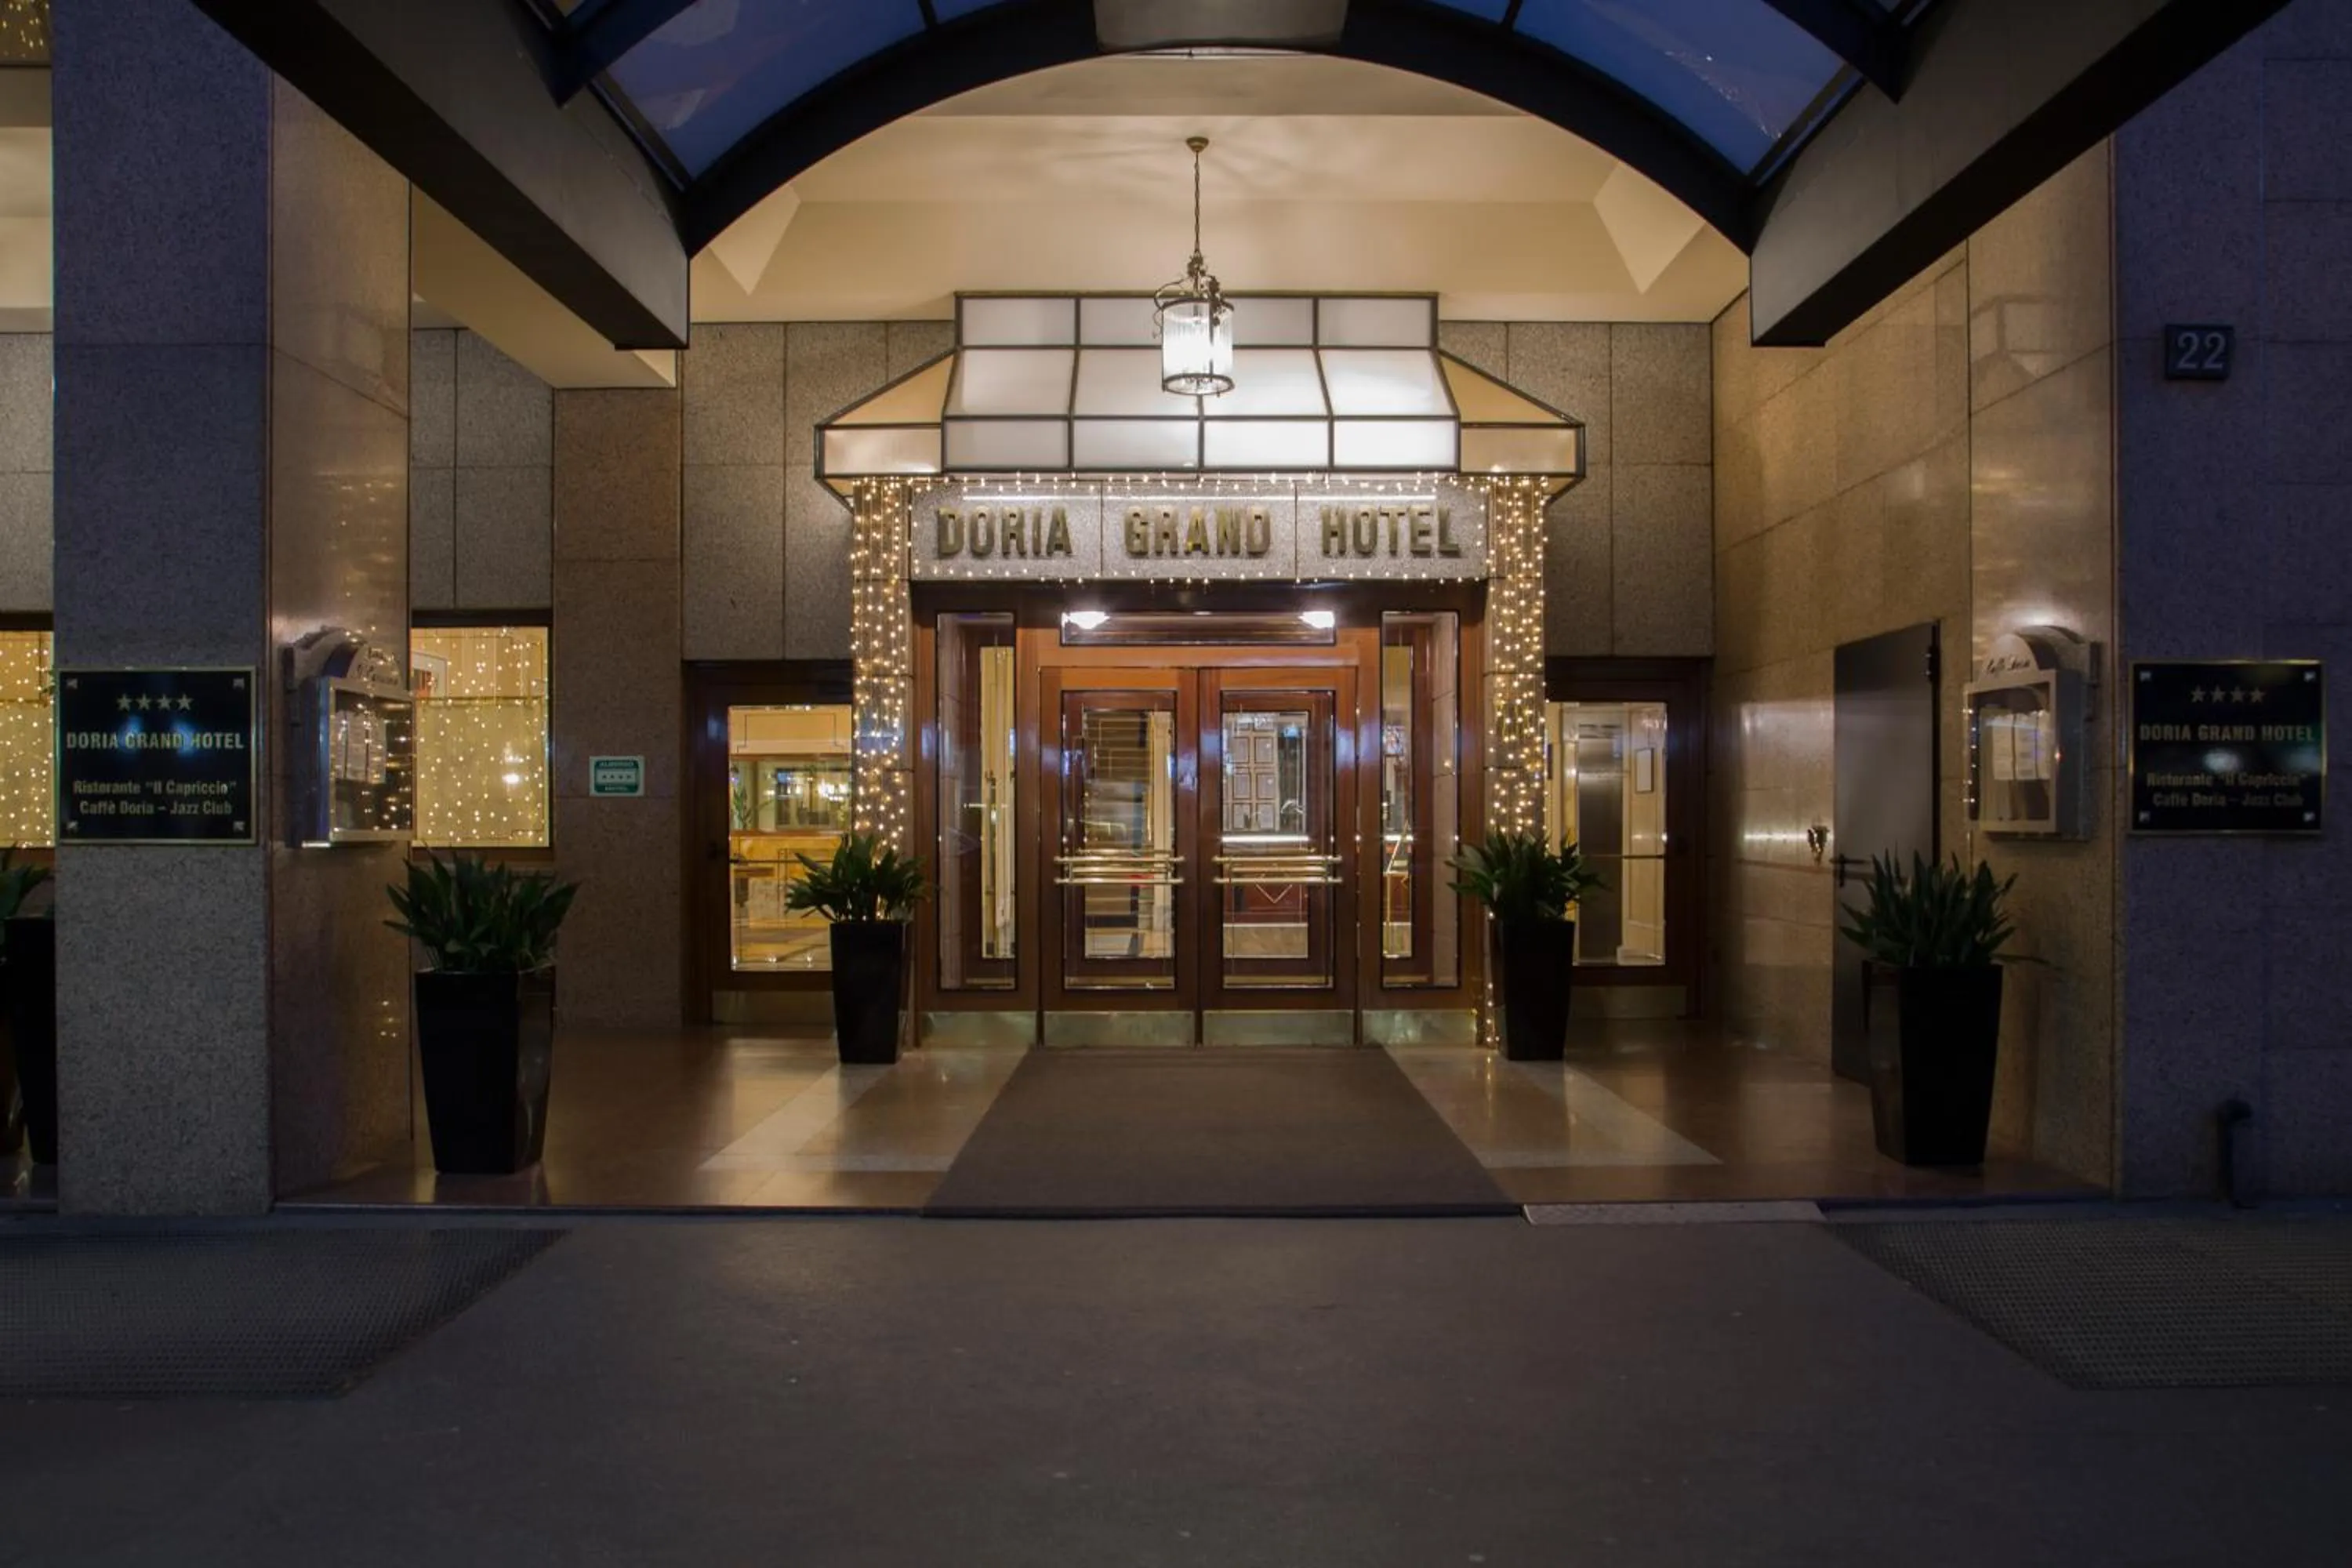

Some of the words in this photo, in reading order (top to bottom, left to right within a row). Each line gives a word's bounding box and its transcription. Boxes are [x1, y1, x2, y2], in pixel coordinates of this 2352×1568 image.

[2177, 332, 2226, 369] 22
[936, 504, 1073, 558] DORIA
[1123, 504, 1272, 558] GRAND
[1320, 504, 1463, 558] HOTEL
[66, 732, 118, 750] DORIA
[125, 732, 182, 750] GRAND
[191, 732, 245, 750] HOTEL
[2140, 724, 2192, 742] DORIA
[2198, 724, 2256, 742] GRAND
[2261, 724, 2314, 742] HOTEL
[74, 780, 141, 795] Ristorante
[119, 800, 154, 815] Doria
[169, 800, 200, 815] Jazz
[202, 800, 232, 815] Club
[2192, 793, 2227, 808] Doria
